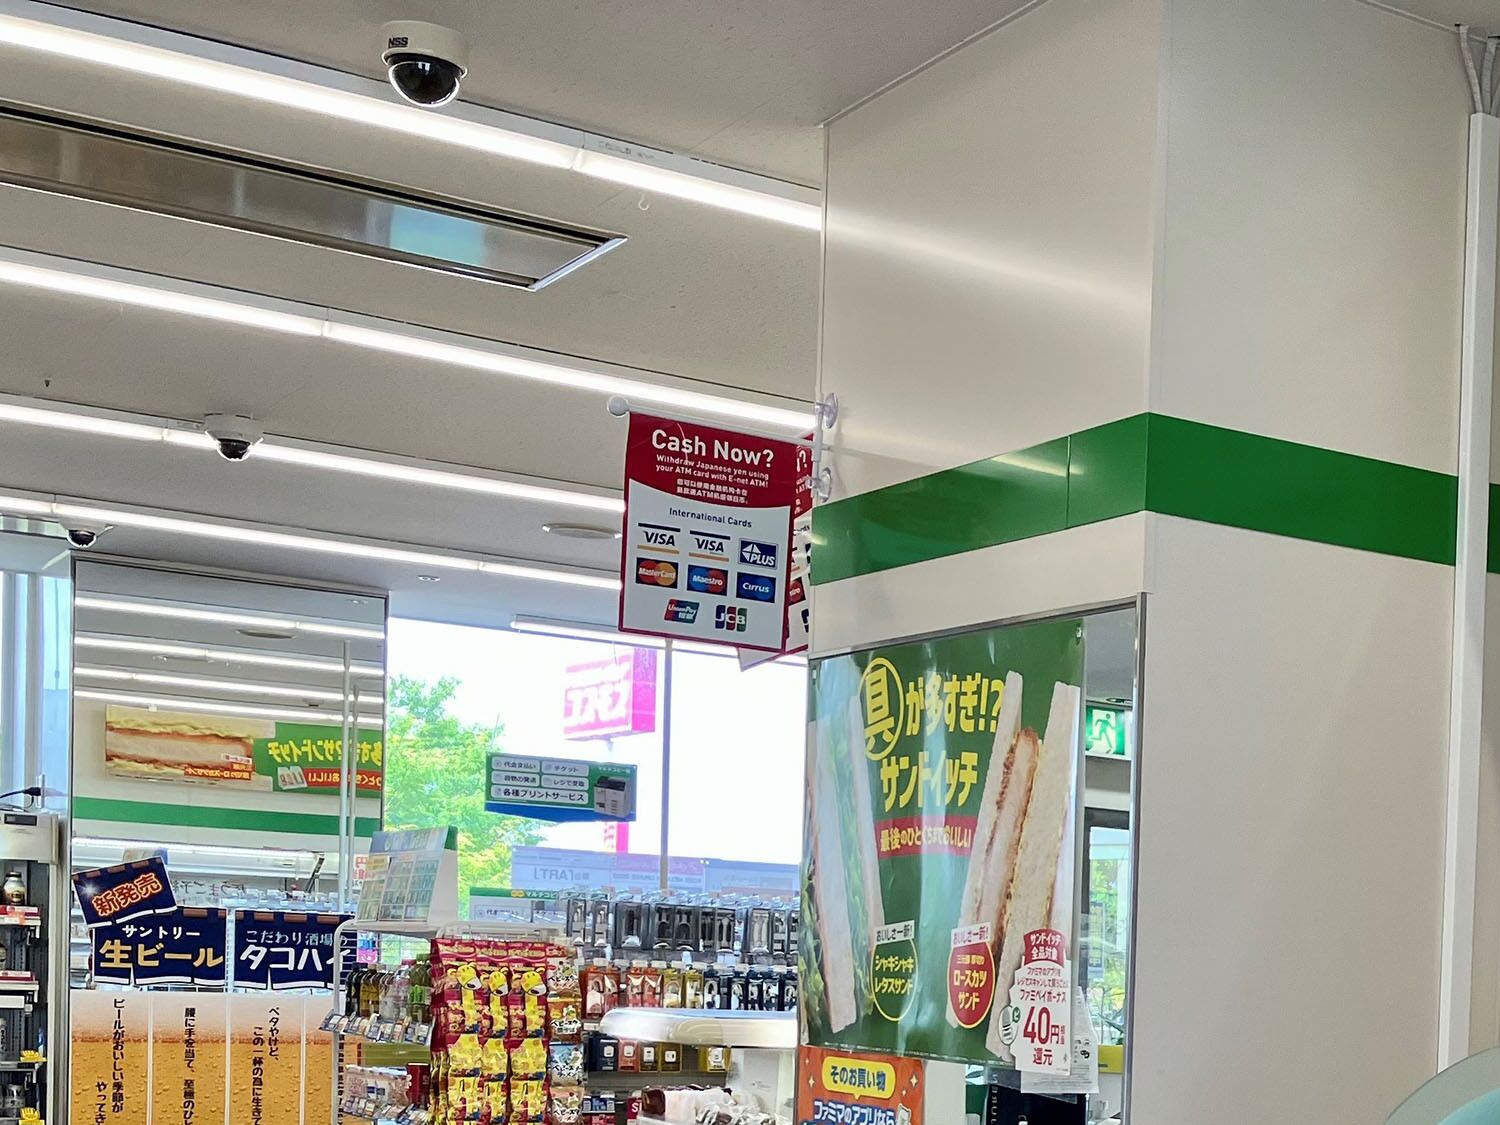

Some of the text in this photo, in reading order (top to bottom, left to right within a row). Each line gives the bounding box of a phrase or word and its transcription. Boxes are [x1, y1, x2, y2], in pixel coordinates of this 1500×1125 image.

[652, 430, 773, 467] Cash Now?
[656, 455, 769, 480] Withdraw Japanese yen using
[656, 464, 768, 488] your ATM card with E-net ATM!
[669, 508, 752, 528] International Cards
[643, 531, 775, 567] VISA VISA PLUS
[638, 567, 770, 593] MasterCard Maestro Cirrus
[716, 612, 746, 625] JCB
[879, 750, 978, 812] サンドイッチ
[503, 788, 585, 802] 各種プリントサービス
[92, 872, 163, 917] 新発売
[122, 924, 200, 940] サントリー
[1030, 932, 1061, 946] サンドイッチ
[99, 939, 223, 971] 生ビール
[875, 955, 914, 973] シャキシャキ
[874, 977, 913, 995] レタスサンド
[953, 970, 987, 988] ロースカツ
[958, 991, 980, 1011] サンド
[1020, 989, 1066, 1004] ファミペイボーナス
[1033, 1047, 1053, 1066] 還元
[830, 1066, 886, 1091] そのお買い物
